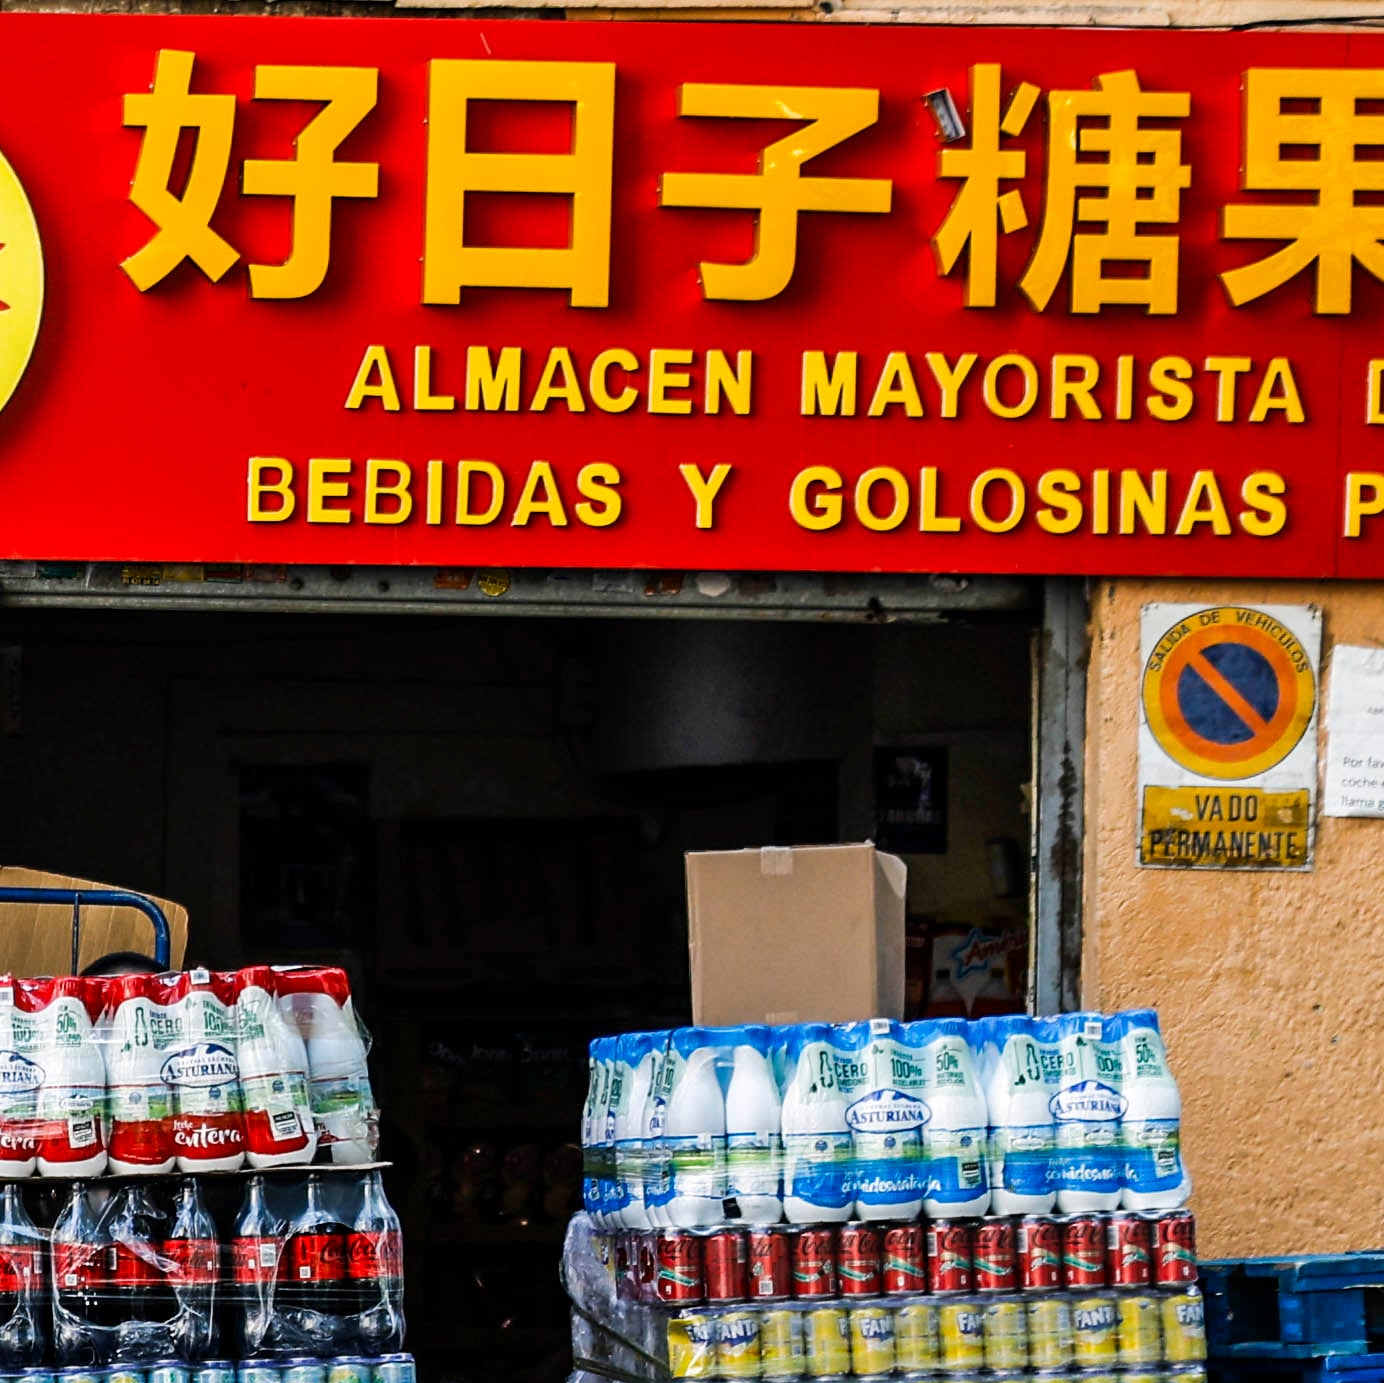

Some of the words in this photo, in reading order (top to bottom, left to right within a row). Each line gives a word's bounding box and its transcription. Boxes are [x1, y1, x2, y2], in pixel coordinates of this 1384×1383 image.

[120, 49, 1384, 314] 好日子糖果
[344, 344, 753, 415] ALMACEN
[800, 349, 1306, 424] MAYORISTA
[246, 456, 623, 528] BEBIDAS
[678, 463, 732, 528] Y
[788, 464, 1288, 536] GOLOSINAS
[1148, 625, 1192, 673] SALIDA
[1199, 611, 1221, 627] DE
[1235, 610, 1309, 674] VEHICULOS
[1195, 794, 1259, 822] VADO
[1148, 828, 1299, 860] PERMANENTE
[834, 1062, 868, 1079] CERO
[891, 1058, 923, 1079] 100%
[1096, 1056, 1123, 1072] 00%
[850, 1109, 925, 1126] ASTURIANA
[174, 1123, 244, 1148] entera
